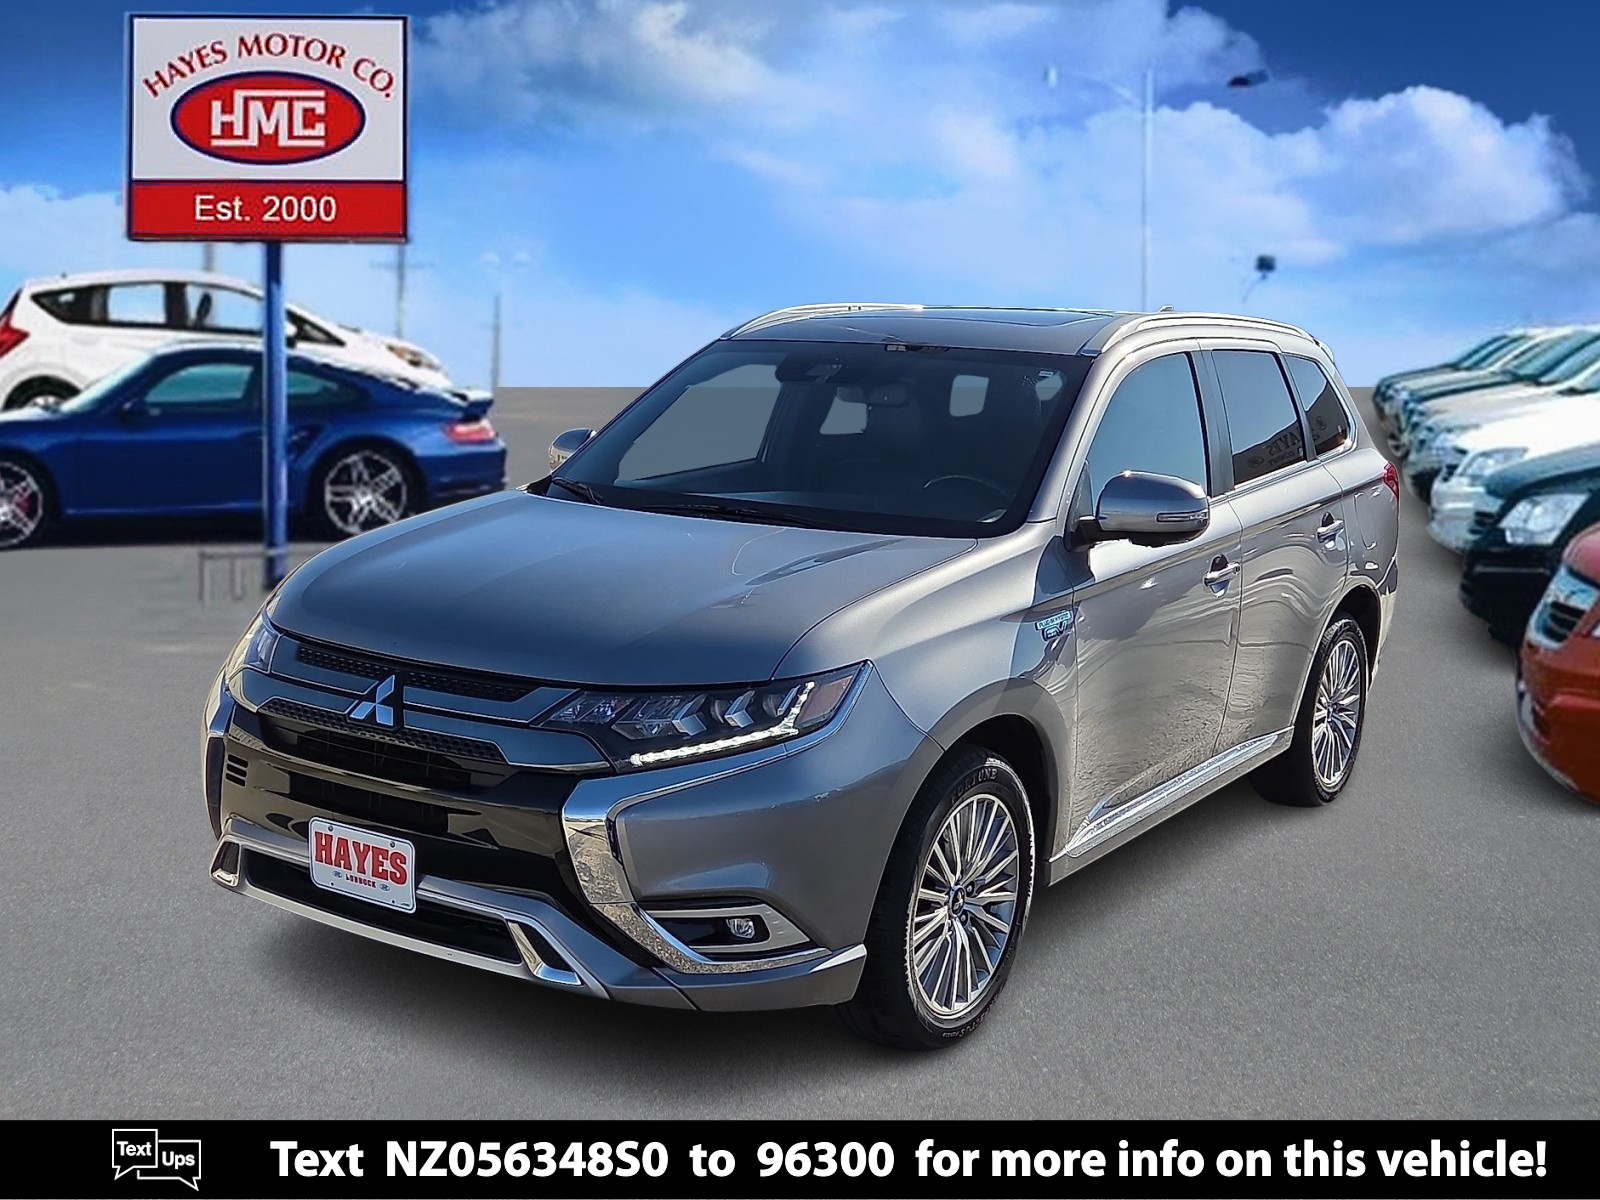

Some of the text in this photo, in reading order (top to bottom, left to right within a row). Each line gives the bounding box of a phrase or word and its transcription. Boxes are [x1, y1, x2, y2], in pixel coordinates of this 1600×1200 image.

[143, 33, 394, 98] HAYES MOTOR CO.
[210, 88, 326, 147] HMC
[194, 194, 337, 222] Est. 2000
[314, 830, 408, 886] HAYES
[345, 873, 377, 889] LUBBOCK
